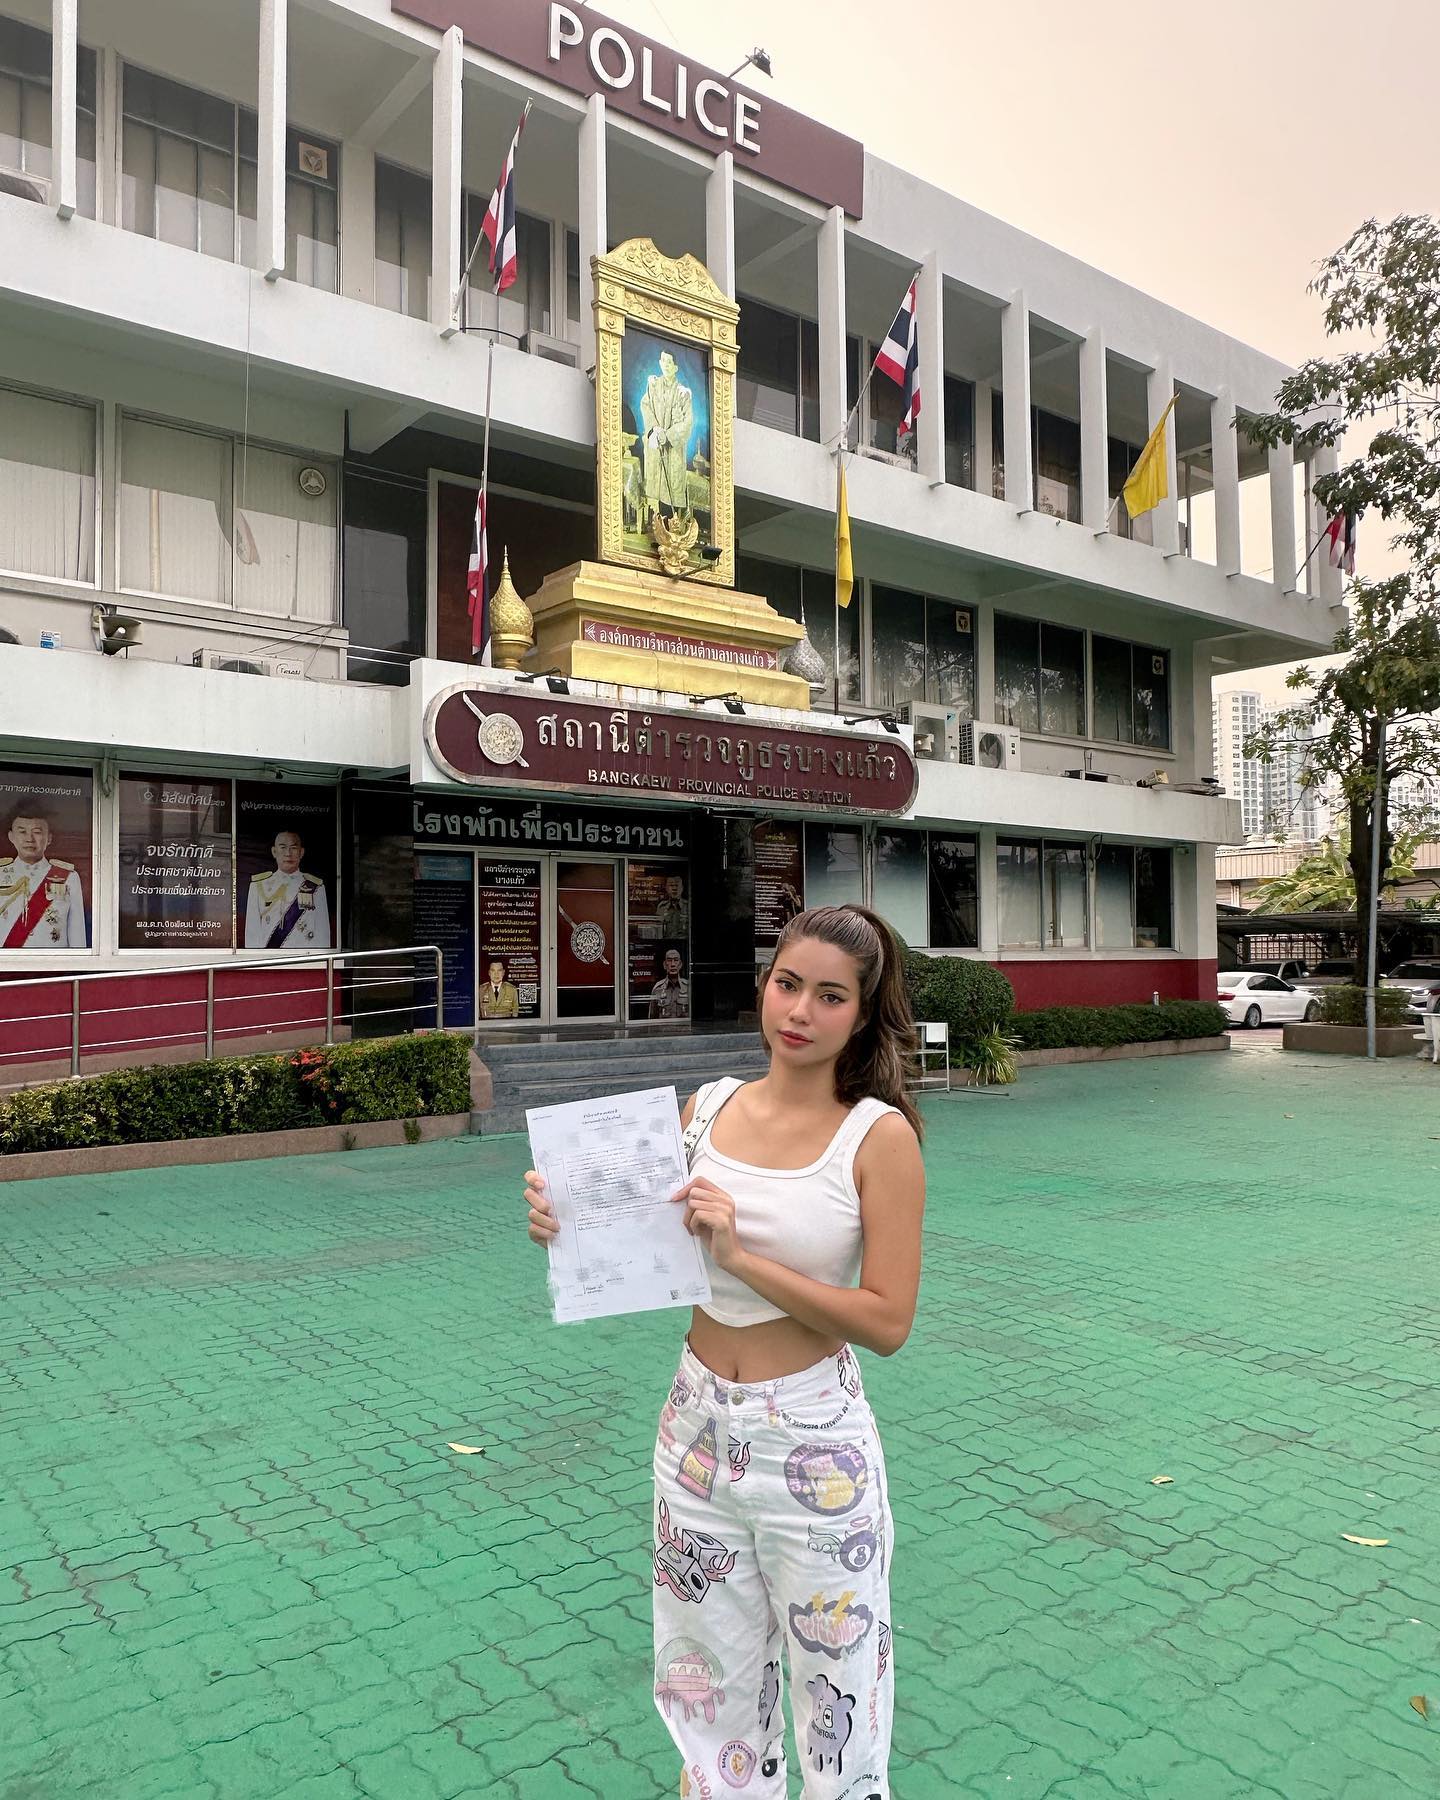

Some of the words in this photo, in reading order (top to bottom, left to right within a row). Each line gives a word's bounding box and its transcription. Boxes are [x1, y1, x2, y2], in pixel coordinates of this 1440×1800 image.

[547, 2, 761, 155] POLICE
[600, 626, 764, 667] องค์การบริหารส่วนตำบลบางแก้ว
[536, 711, 896, 781] สถานีตำรวจภูธรบางแก้ว
[588, 769, 671, 789] BANGKAEW
[678, 778, 751, 796] PROVINCIAL
[756, 785, 798, 800] POLICE
[802, 788, 851, 804] STATION
[413, 801, 684, 848] โรงพักเพื่อประชาชน
[136, 864, 221, 878] ประเทศชาติมั่นคง
[147, 843, 214, 858] จงรักภักดี
